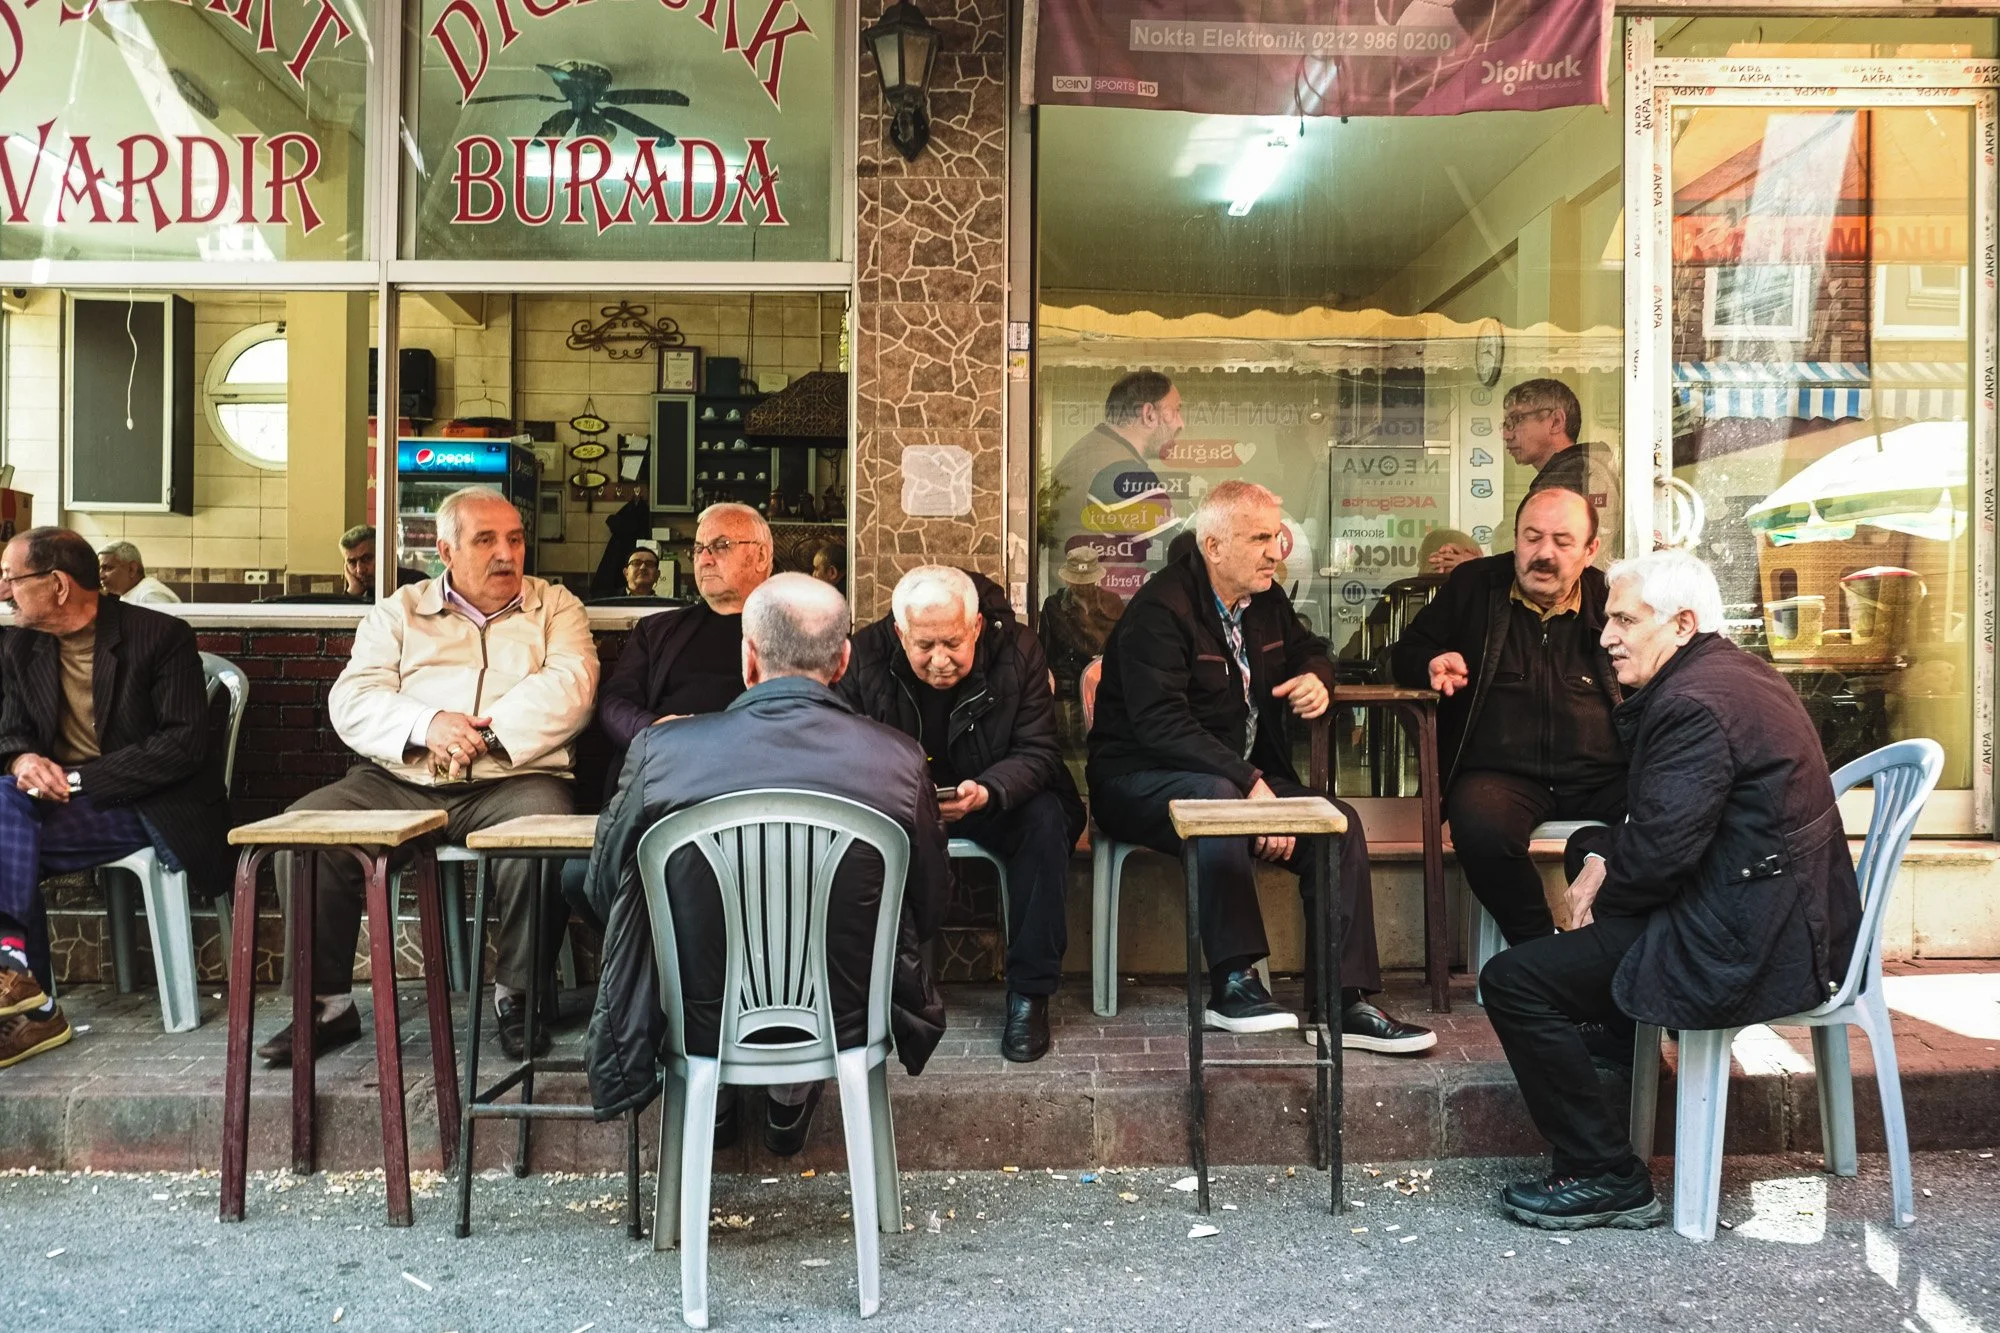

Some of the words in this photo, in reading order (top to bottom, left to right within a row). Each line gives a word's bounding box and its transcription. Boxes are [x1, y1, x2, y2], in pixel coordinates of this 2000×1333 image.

[1134, 26, 1195, 46] Nokta
[1202, 28, 1305, 48] Elektronik
[1312, 31, 1357, 49] 0212
[1363, 32, 1397, 50] 986
[1404, 32, 1450, 51] 0200
[1095, 81, 1135, 92] SPORTS
[1140, 84, 1156, 95] HD
[1481, 55, 1582, 96] Digiturk
[1739, 74, 1772, 83] AKPA
[1861, 74, 1893, 83] AKPA
[1642, 98, 1652, 130] AKPA
[1985, 122, 1995, 154] AKPA
[0, 117, 324, 237] VARDIR
[451, 136, 790, 237] BURADA
[1653, 174, 1663, 208] AKPA
[1985, 244, 1995, 278] AKPA
[1653, 294, 1662, 329] AKPA
[1985, 366, 1995, 399] AKPA
[437, 451, 476, 466] pepsi
[1984, 488, 1995, 522] AKPA
[1984, 610, 1994, 644] AKPA
[1982, 732, 1993, 765] AKPA
